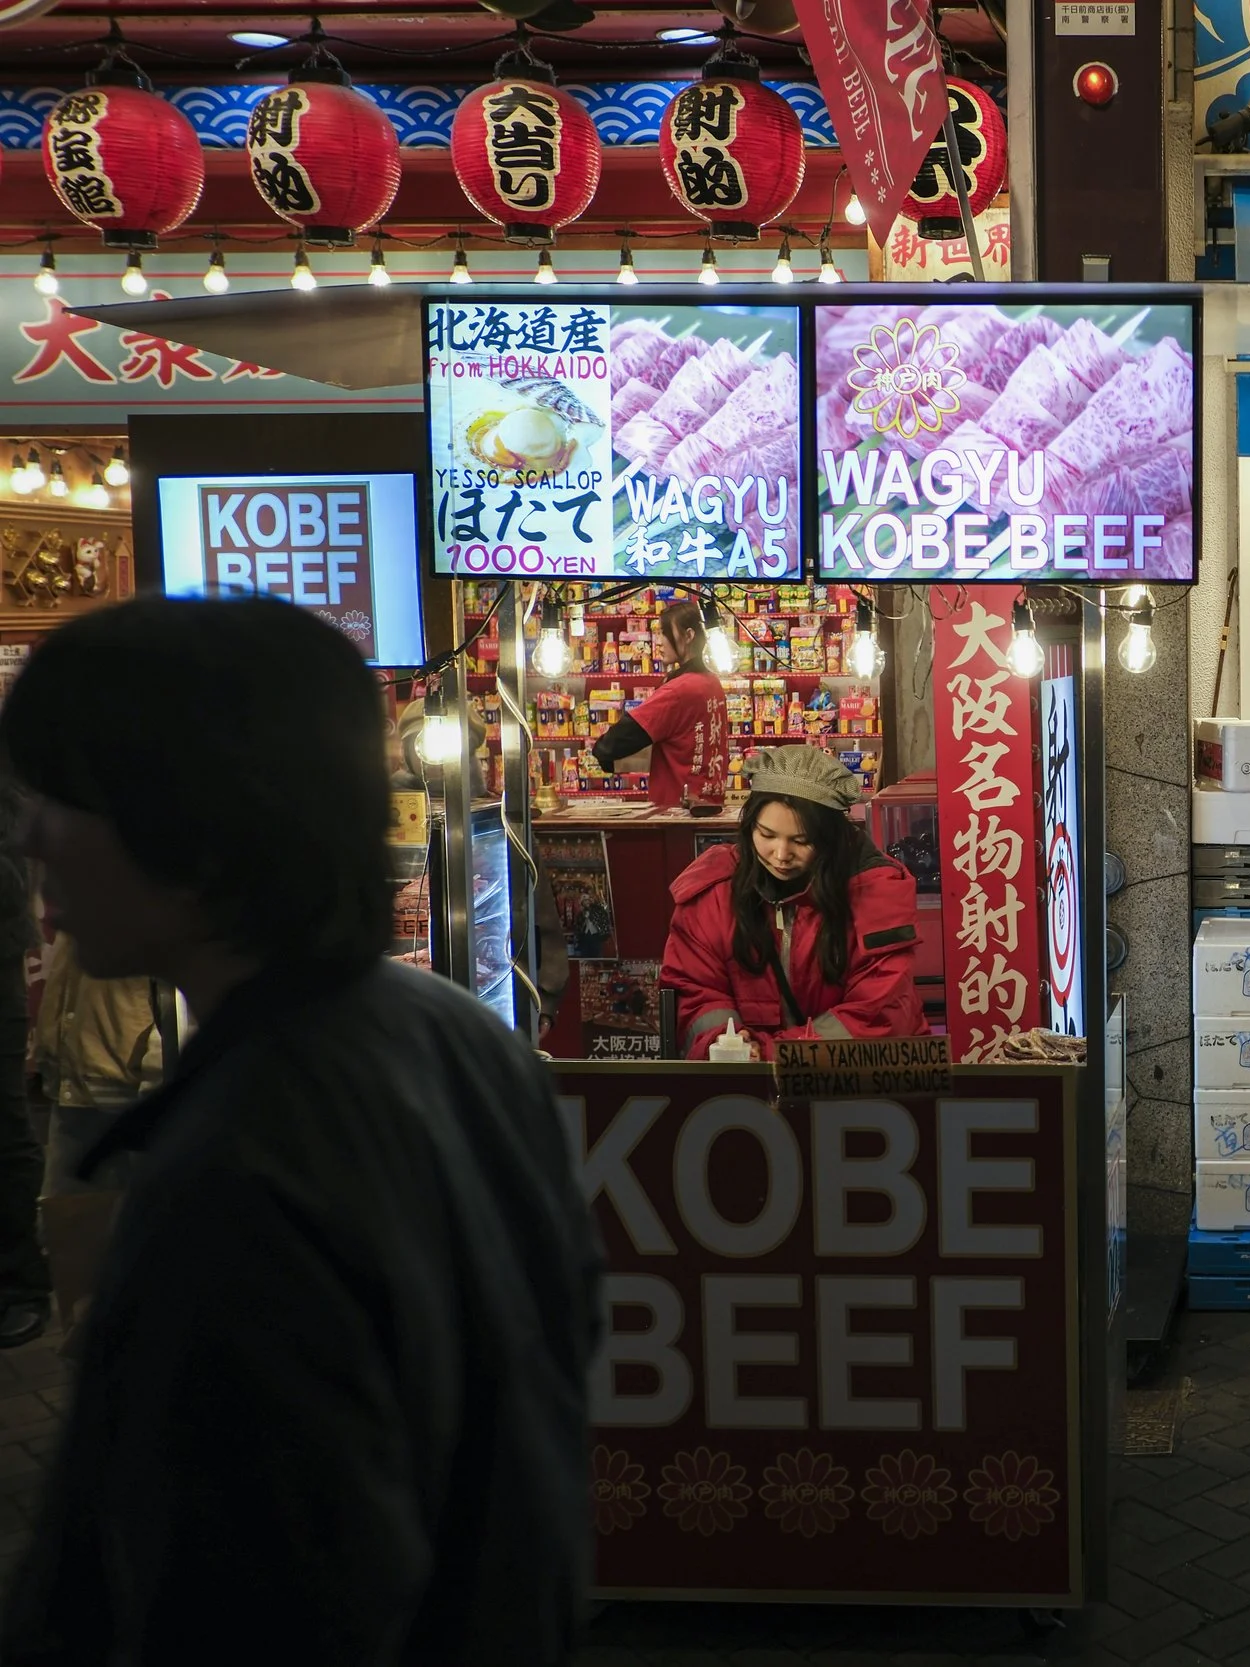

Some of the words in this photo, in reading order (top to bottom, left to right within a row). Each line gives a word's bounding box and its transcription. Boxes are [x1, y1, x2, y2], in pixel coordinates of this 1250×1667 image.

[843, 66, 871, 141] BEEF
[487, 86, 558, 207] 大当り
[674, 85, 743, 207] 射的
[429, 306, 606, 355] 北海道産
[429, 359, 482, 379] from
[489, 355, 608, 380] HOKKAIDO
[873, 367, 943, 393] 神戸肉
[435, 470, 499, 490] YESSO
[513, 470, 602, 490] SCALLOP
[624, 474, 789, 524] WAGYU
[821, 449, 1046, 507] WAGYU
[207, 491, 363, 548] KOBE
[439, 490, 601, 543] ほたて
[822, 513, 992, 571] KOBE
[1010, 513, 1166, 571] BEEF
[217, 550, 358, 605] BEEF
[447, 545, 543, 573] 1000
[547, 556, 595, 573] YEN
[592, 1035, 661, 1052] 大阪万博
[779, 1044, 818, 1069] SALT
[780, 1072, 861, 1097] TERIYAKI
[553, 1094, 1044, 1259] KOBE
[588, 1273, 1026, 1432] BEEF
